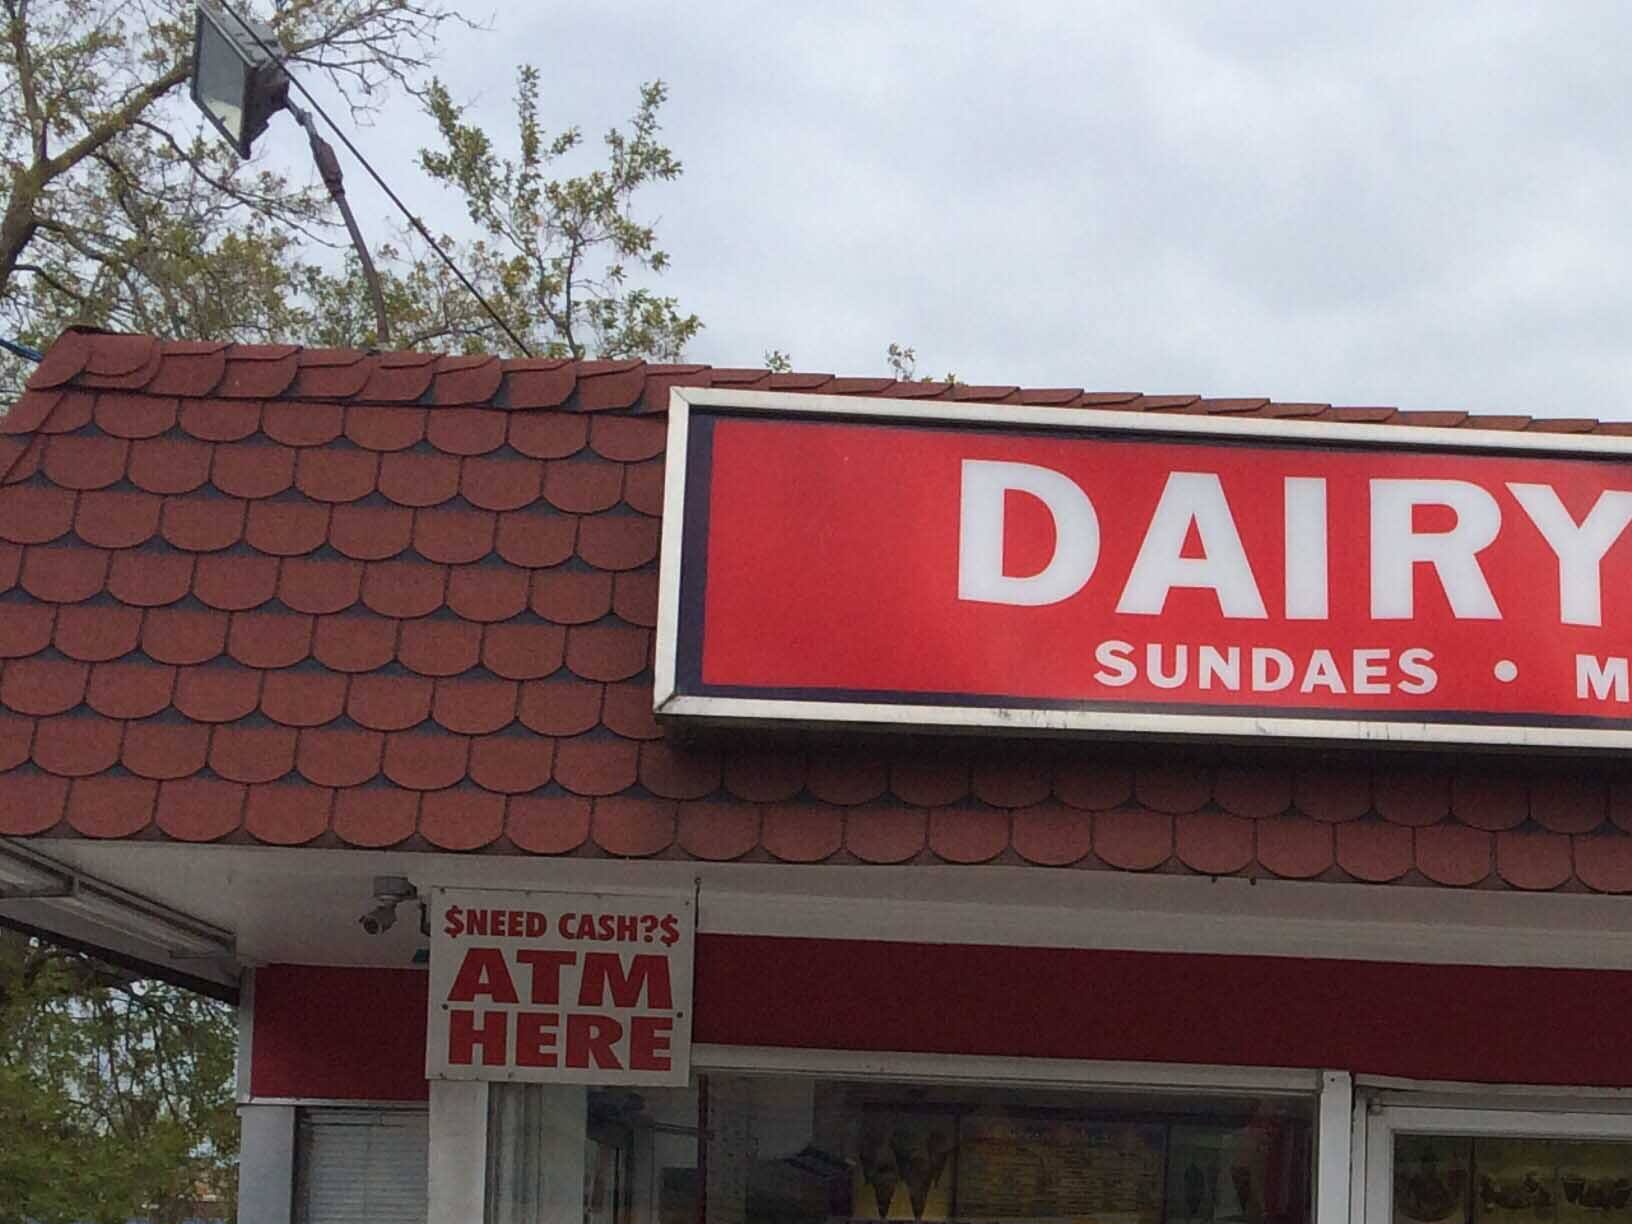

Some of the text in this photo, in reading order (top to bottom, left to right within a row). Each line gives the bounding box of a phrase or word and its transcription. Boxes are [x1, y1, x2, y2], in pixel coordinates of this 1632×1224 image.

[1092, 639, 1439, 695] SUNDAES
[444, 905, 681, 948] $NEED CASH?$
[447, 947, 674, 1010] ATM
[448, 1009, 674, 1072] HERE
